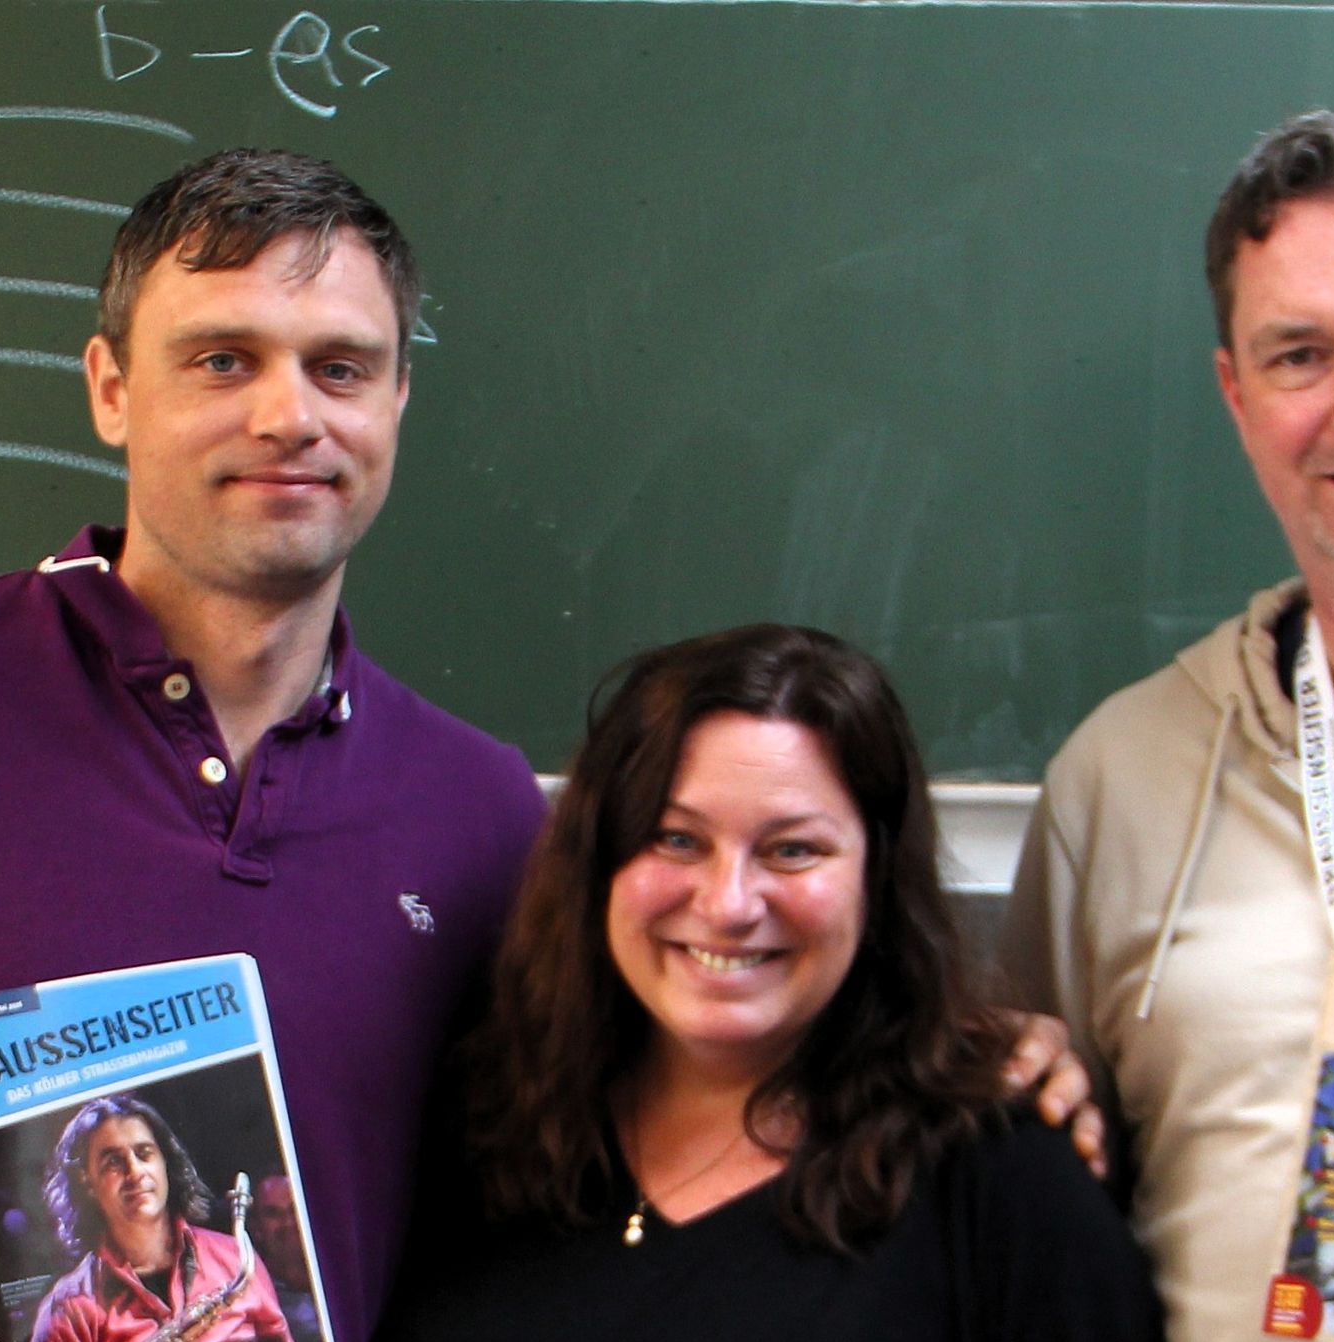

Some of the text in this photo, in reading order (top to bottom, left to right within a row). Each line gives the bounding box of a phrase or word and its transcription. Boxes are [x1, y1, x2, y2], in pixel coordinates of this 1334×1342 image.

[5, 1039, 188, 1105] DAS KÖLNER STRASSENMAGAZIN
